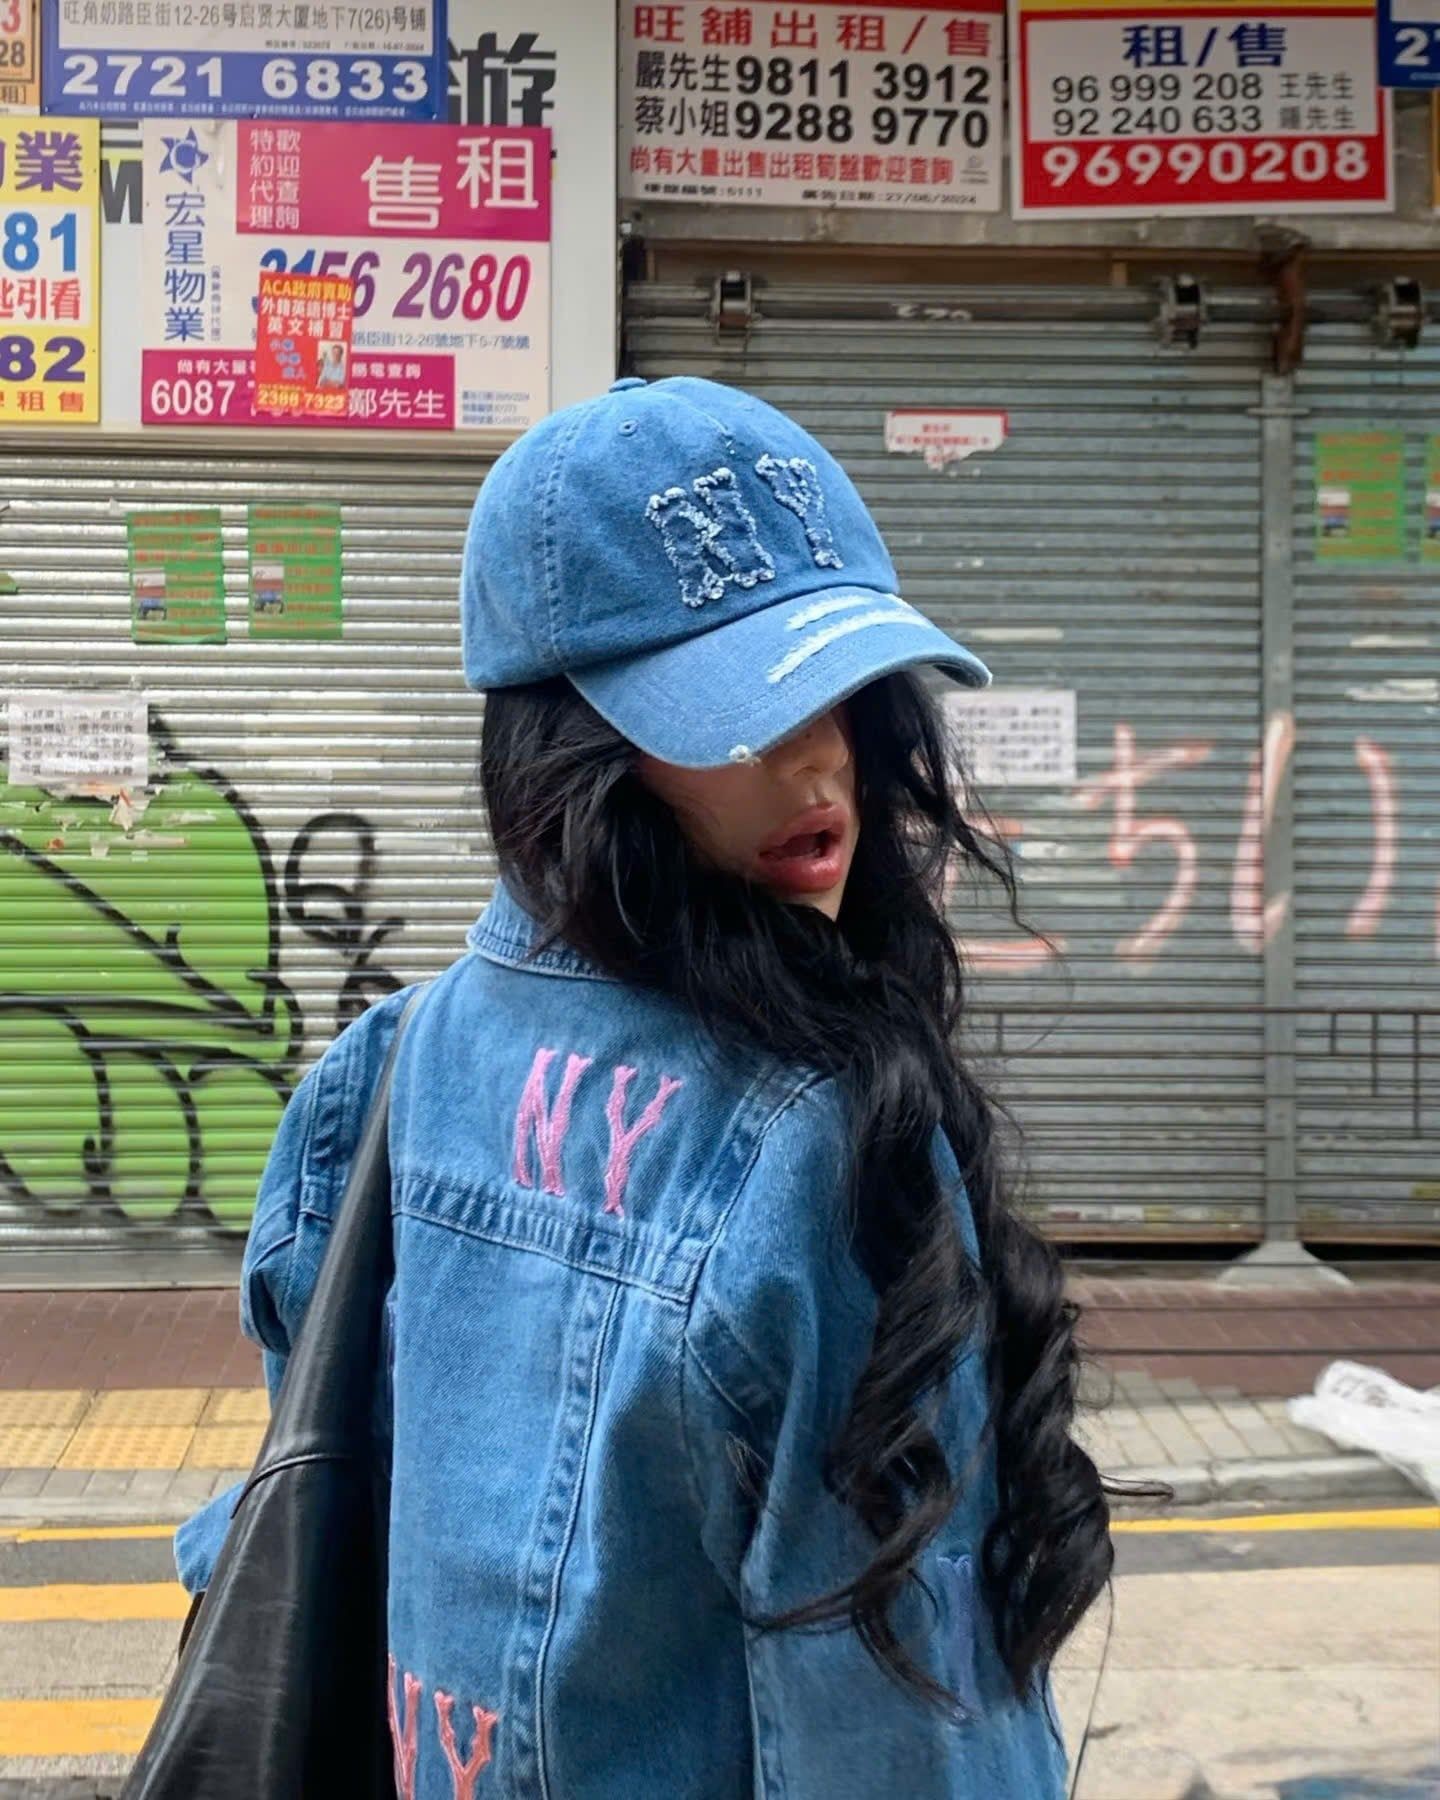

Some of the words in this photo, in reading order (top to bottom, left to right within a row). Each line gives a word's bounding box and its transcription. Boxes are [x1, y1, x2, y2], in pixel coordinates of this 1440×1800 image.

[1122, 22, 1287, 69] 租/售
[1394, 27, 1440, 66] 2
[62, 54, 223, 97] 2721
[261, 58, 428, 101] 6833
[736, 55, 849, 99] 9811
[873, 61, 990, 104] 3912
[1051, 76, 1098, 103] 96
[1109, 75, 1181, 102] 999
[1192, 73, 1263, 101] 208
[1279, 72, 1354, 100] 王先生
[634, 95, 729, 137] 蔡小姐
[735, 100, 853, 143] 9288
[872, 106, 988, 149] 9770
[1052, 108, 1099, 136] 92
[1112, 107, 1181, 134] 240
[1192, 106, 1262, 133] 633
[0, 131, 83, 192] 業
[457, 136, 540, 209] 租
[1042, 140, 1369, 188] 96990208
[361, 155, 444, 229] 售
[3, 212, 77, 272] 81
[164, 191, 206, 342] 宏星物業
[392, 252, 531, 322] 2680
[0, 335, 86, 382] 82
[177, 359, 256, 376] 尚有大量
[0, 390, 85, 414] 租售
[151, 379, 236, 416] 6087
[512, 1047, 684, 1219] NY
